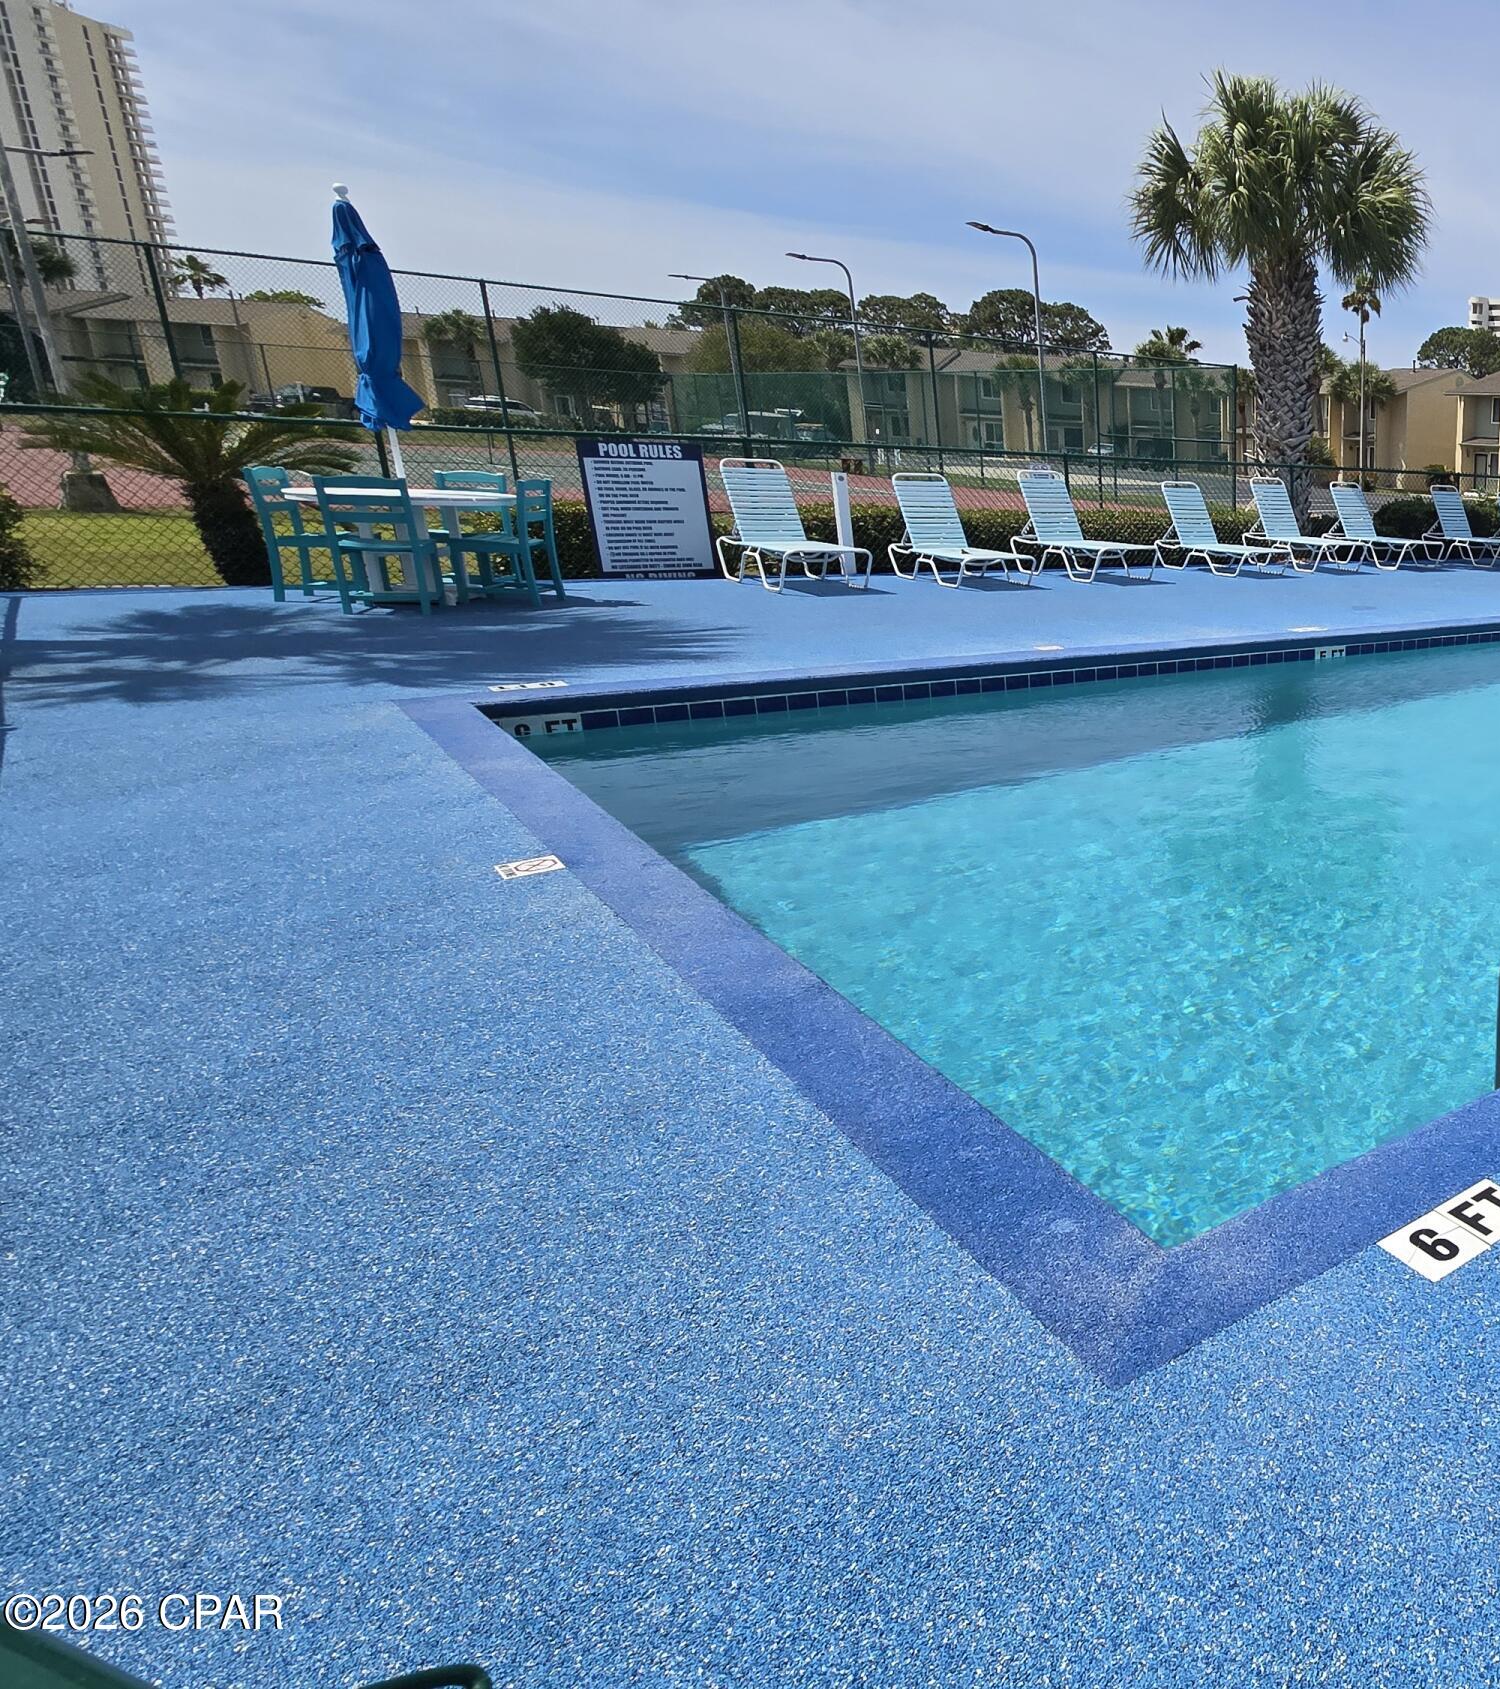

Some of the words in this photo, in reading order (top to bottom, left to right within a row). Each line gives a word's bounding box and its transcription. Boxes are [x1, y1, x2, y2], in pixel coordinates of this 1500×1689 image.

[598, 443, 636, 457] POOL
[638, 444, 682, 458] RULES
[544, 718, 578, 733] FT
[1409, 1228, 1460, 1262] 6
